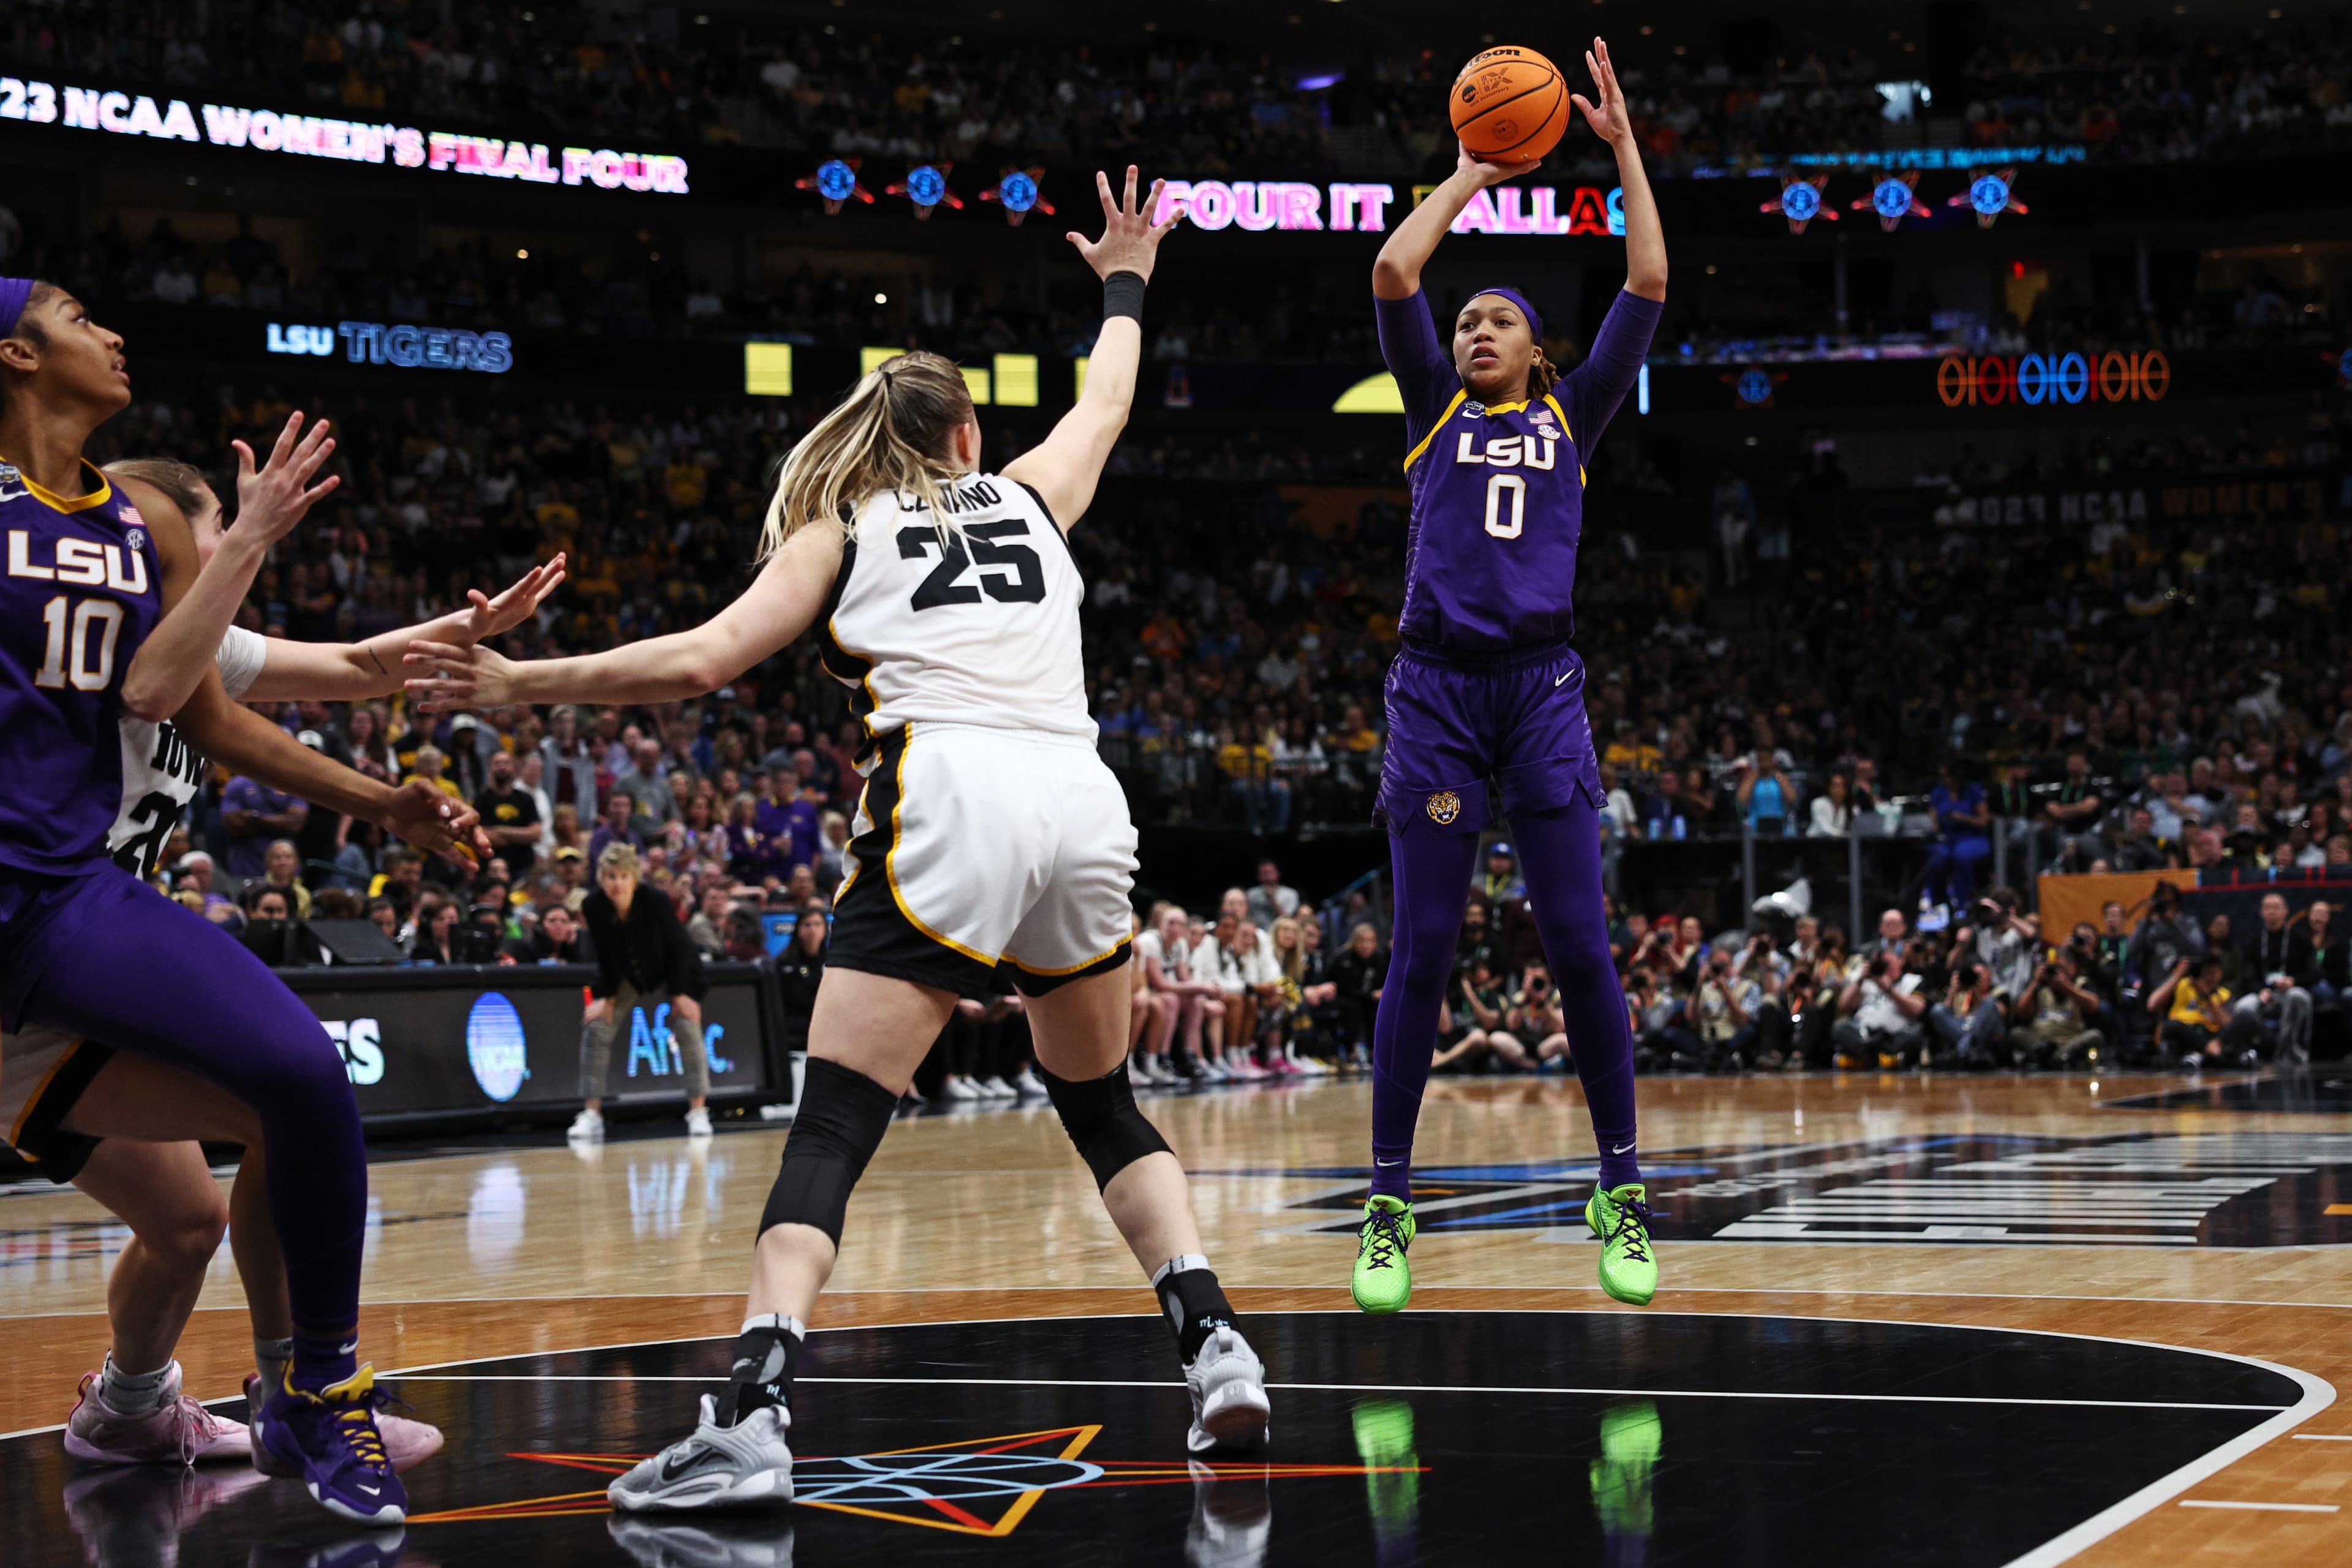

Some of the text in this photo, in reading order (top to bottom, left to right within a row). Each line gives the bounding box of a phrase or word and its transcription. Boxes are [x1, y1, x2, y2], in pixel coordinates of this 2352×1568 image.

[0, 77, 689, 194] 23 NCAA WOMEN'S FINAL FOUR
[1150, 180, 1324, 232] FOUR
[1329, 183, 1393, 232] IT
[266, 320, 513, 372] LSU TIGERS
[1456, 432, 1556, 470] LSU
[1485, 473, 1526, 540] 0
[1970, 493, 2046, 527] 023
[8, 530, 148, 595] LSU
[896, 519, 1046, 612] 25
[34, 596, 124, 692] 10
[151, 723, 205, 787] IOW
